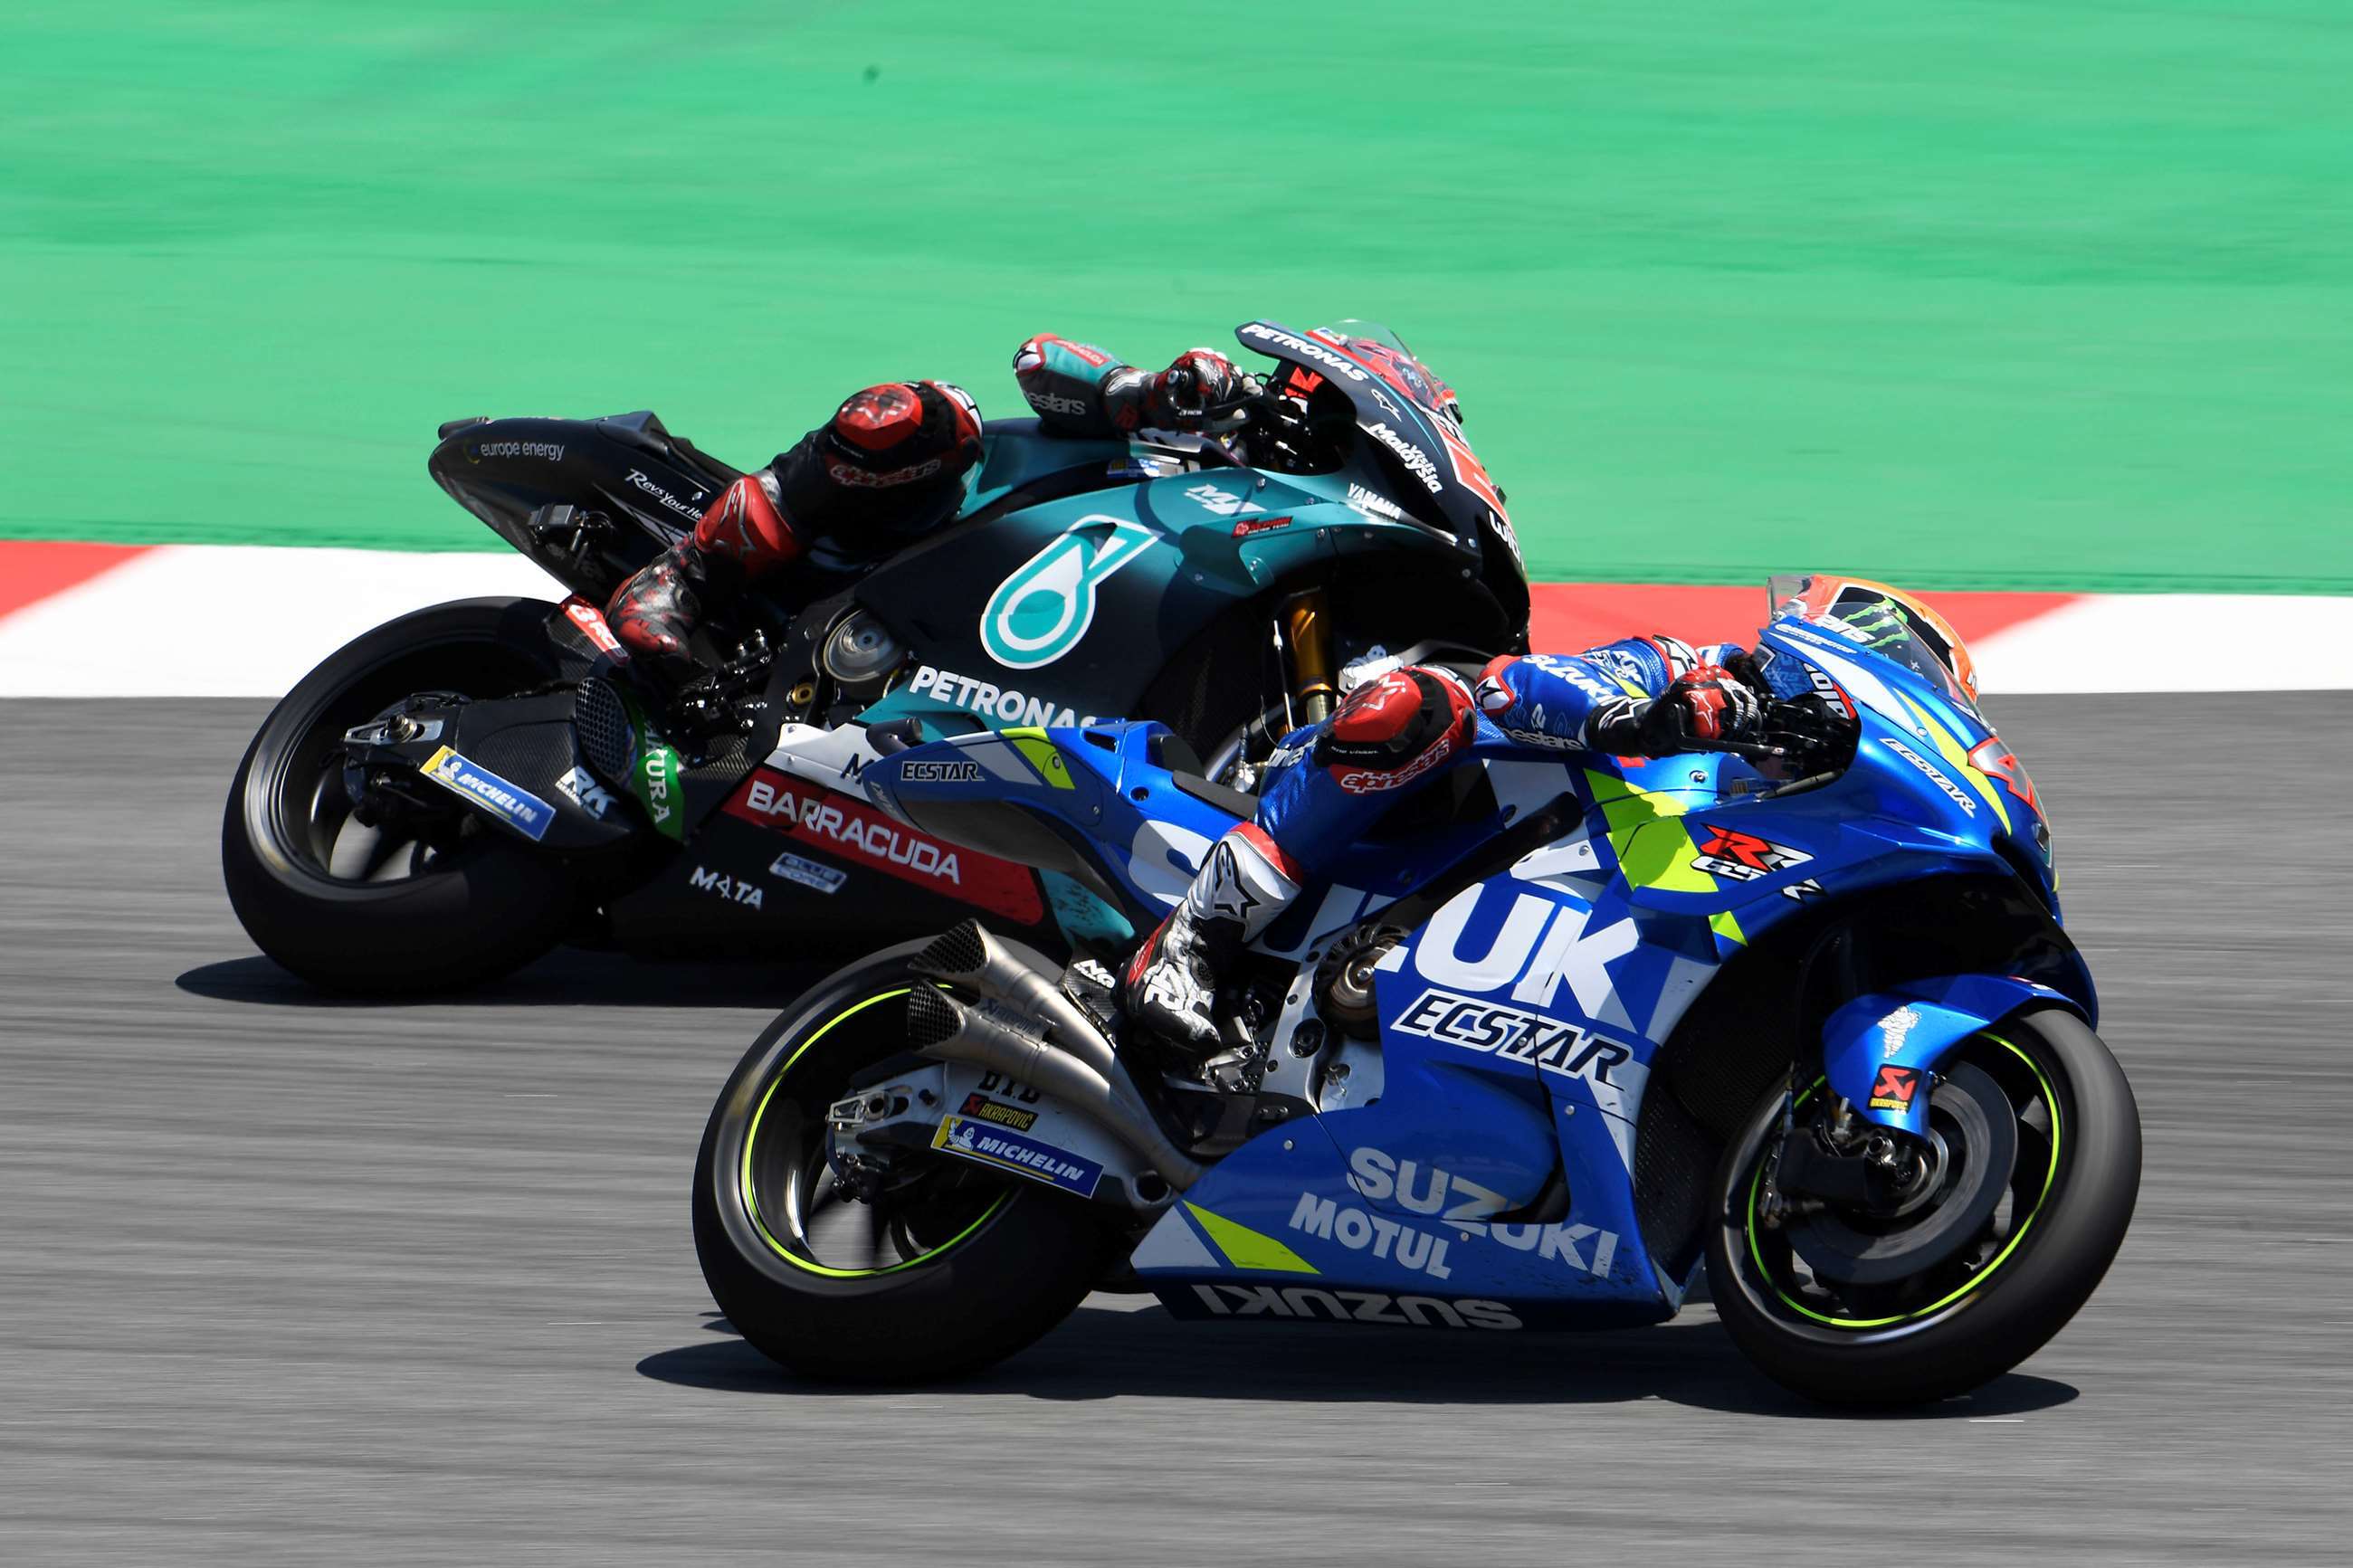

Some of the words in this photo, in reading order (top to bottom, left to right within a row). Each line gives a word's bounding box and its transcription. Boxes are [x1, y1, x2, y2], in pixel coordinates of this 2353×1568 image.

[1241, 323, 1369, 382] PETRONAS
[481, 442, 520, 459] europe
[522, 442, 565, 461] energy
[1368, 423, 1443, 494] Malaysia
[624, 469, 663, 498] Revs
[1347, 482, 1404, 520] YAMAHA
[459, 772, 539, 822] MICHELIN
[900, 761, 986, 782] ECSTAR
[1879, 737, 1979, 818] ECSTAR
[747, 780, 960, 885] BARRACUDA
[1391, 987, 1634, 1092] ECSTAR
[977, 1136, 1085, 1182] MICHELIN
[1289, 1193, 1452, 1280] MOTUL
[1347, 1146, 1619, 1279] SUZUKI
[1192, 1284, 1522, 1331] SUZUKI
